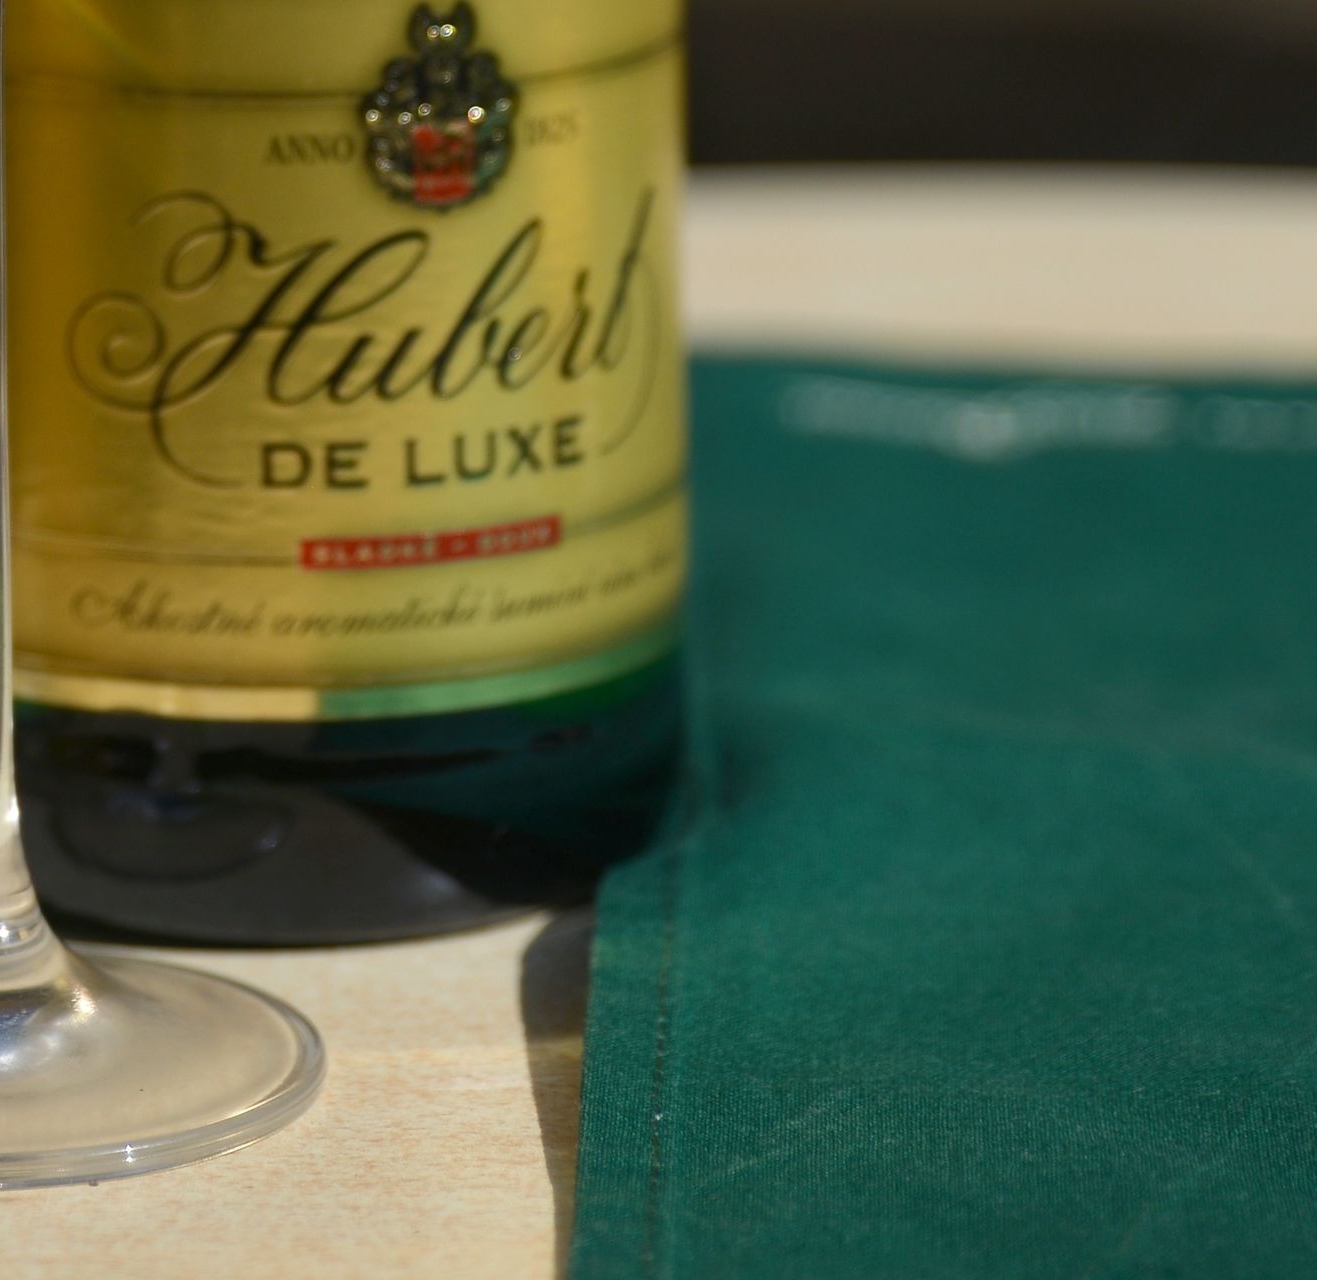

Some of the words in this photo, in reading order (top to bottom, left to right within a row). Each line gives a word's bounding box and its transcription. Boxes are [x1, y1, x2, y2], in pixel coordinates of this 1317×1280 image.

[66, 187, 658, 410] Hubert
[261, 442, 368, 491] DE
[405, 415, 588, 487] LUXE
